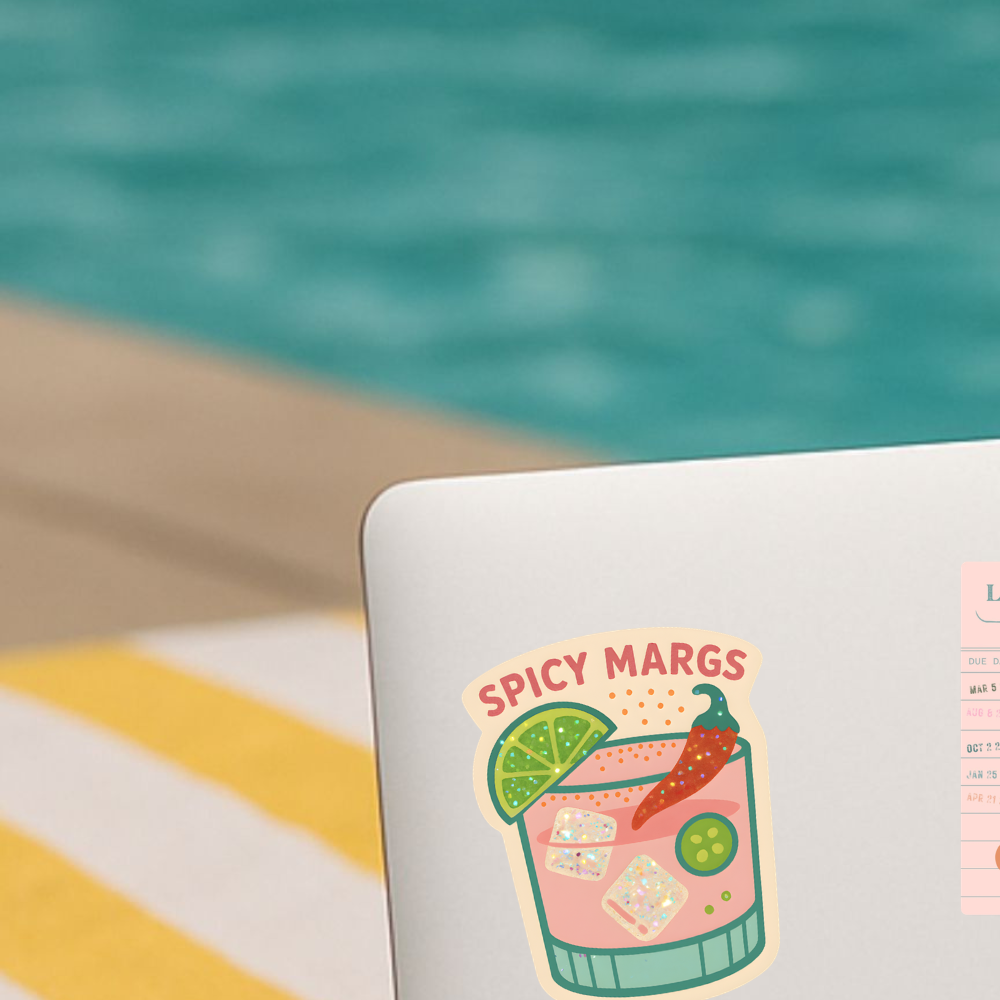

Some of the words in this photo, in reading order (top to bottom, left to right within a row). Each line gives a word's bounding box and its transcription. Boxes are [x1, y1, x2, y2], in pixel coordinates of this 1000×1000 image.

[968, 657, 987, 666] DUE
[478, 651, 587, 717] SPICY
[604, 642, 747, 681] MARGS
[969, 684, 988, 694] MAR
[991, 683, 997, 692] 5
[966, 708, 984, 717] AUG
[967, 743, 983, 753] OCT
[986, 742, 992, 752] 2
[966, 770, 983, 779] JAN
[986, 770, 997, 779] 25
[967, 792, 983, 803] APR
[987, 795, 997, 804] 21
